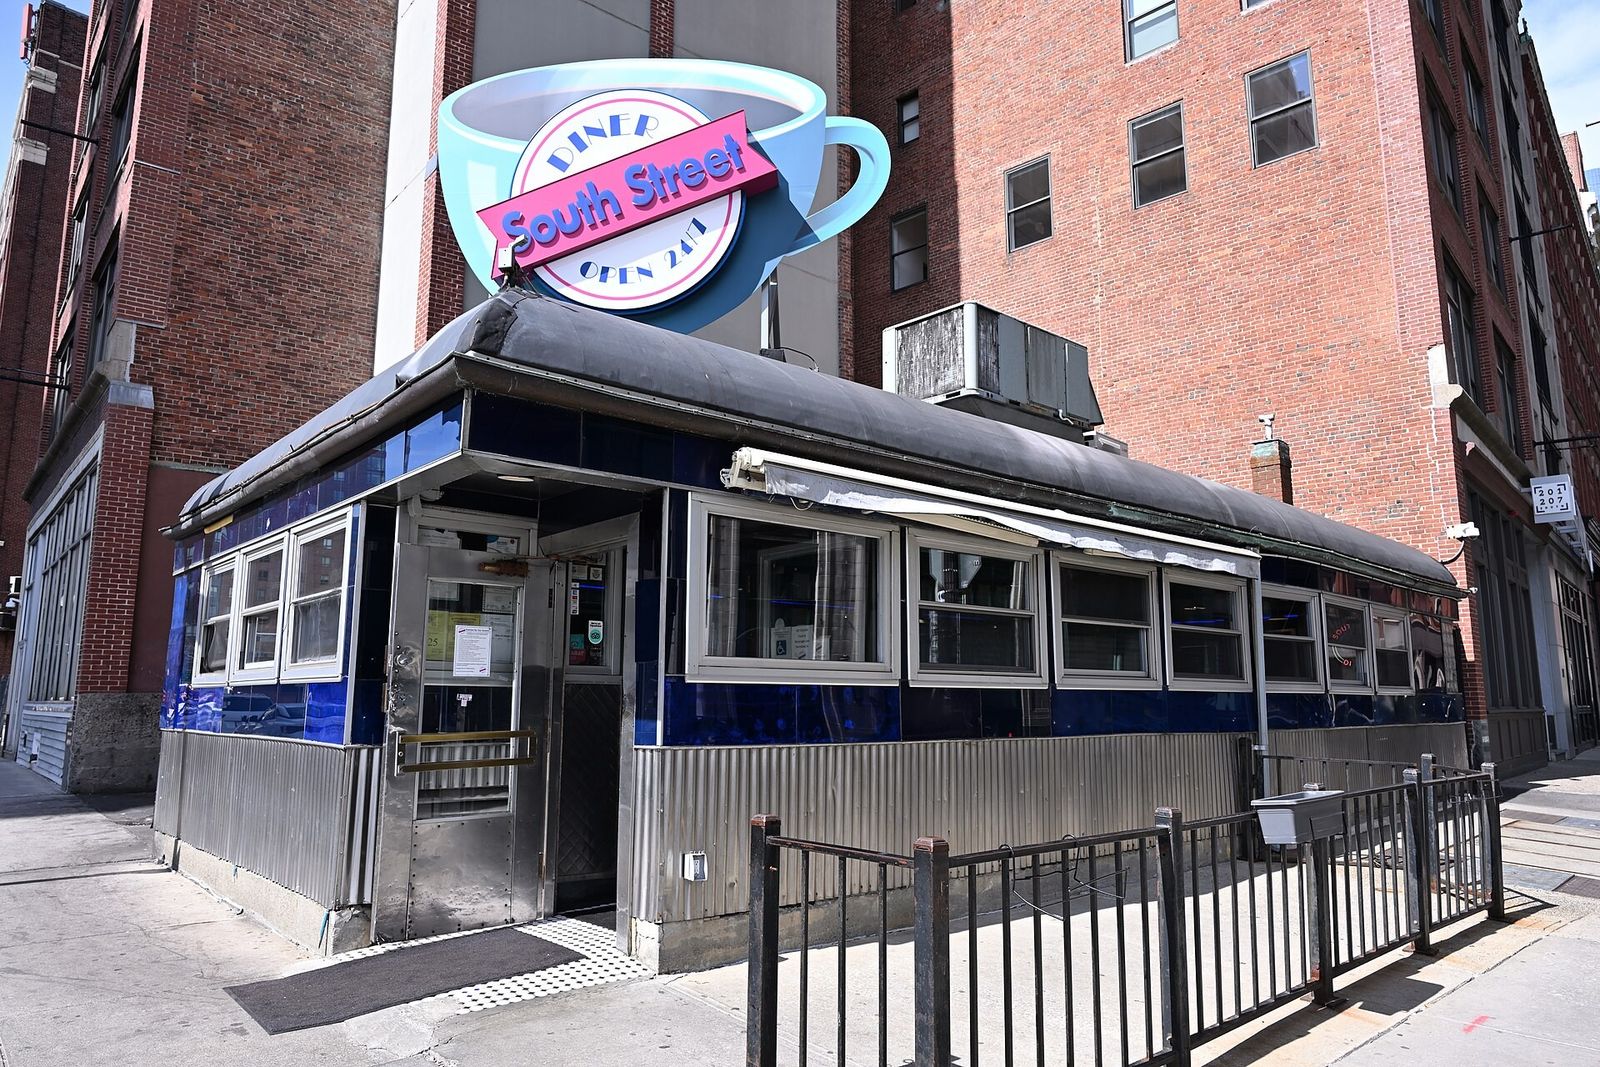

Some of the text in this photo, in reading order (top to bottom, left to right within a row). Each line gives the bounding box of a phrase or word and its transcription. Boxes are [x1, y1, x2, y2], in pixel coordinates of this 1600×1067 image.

[547, 113, 659, 173] DINER
[502, 133, 744, 254] South Street
[580, 217, 707, 285] OPEN 24/7
[1538, 488, 1562, 496] 201
[1540, 496, 1563, 505] 207
